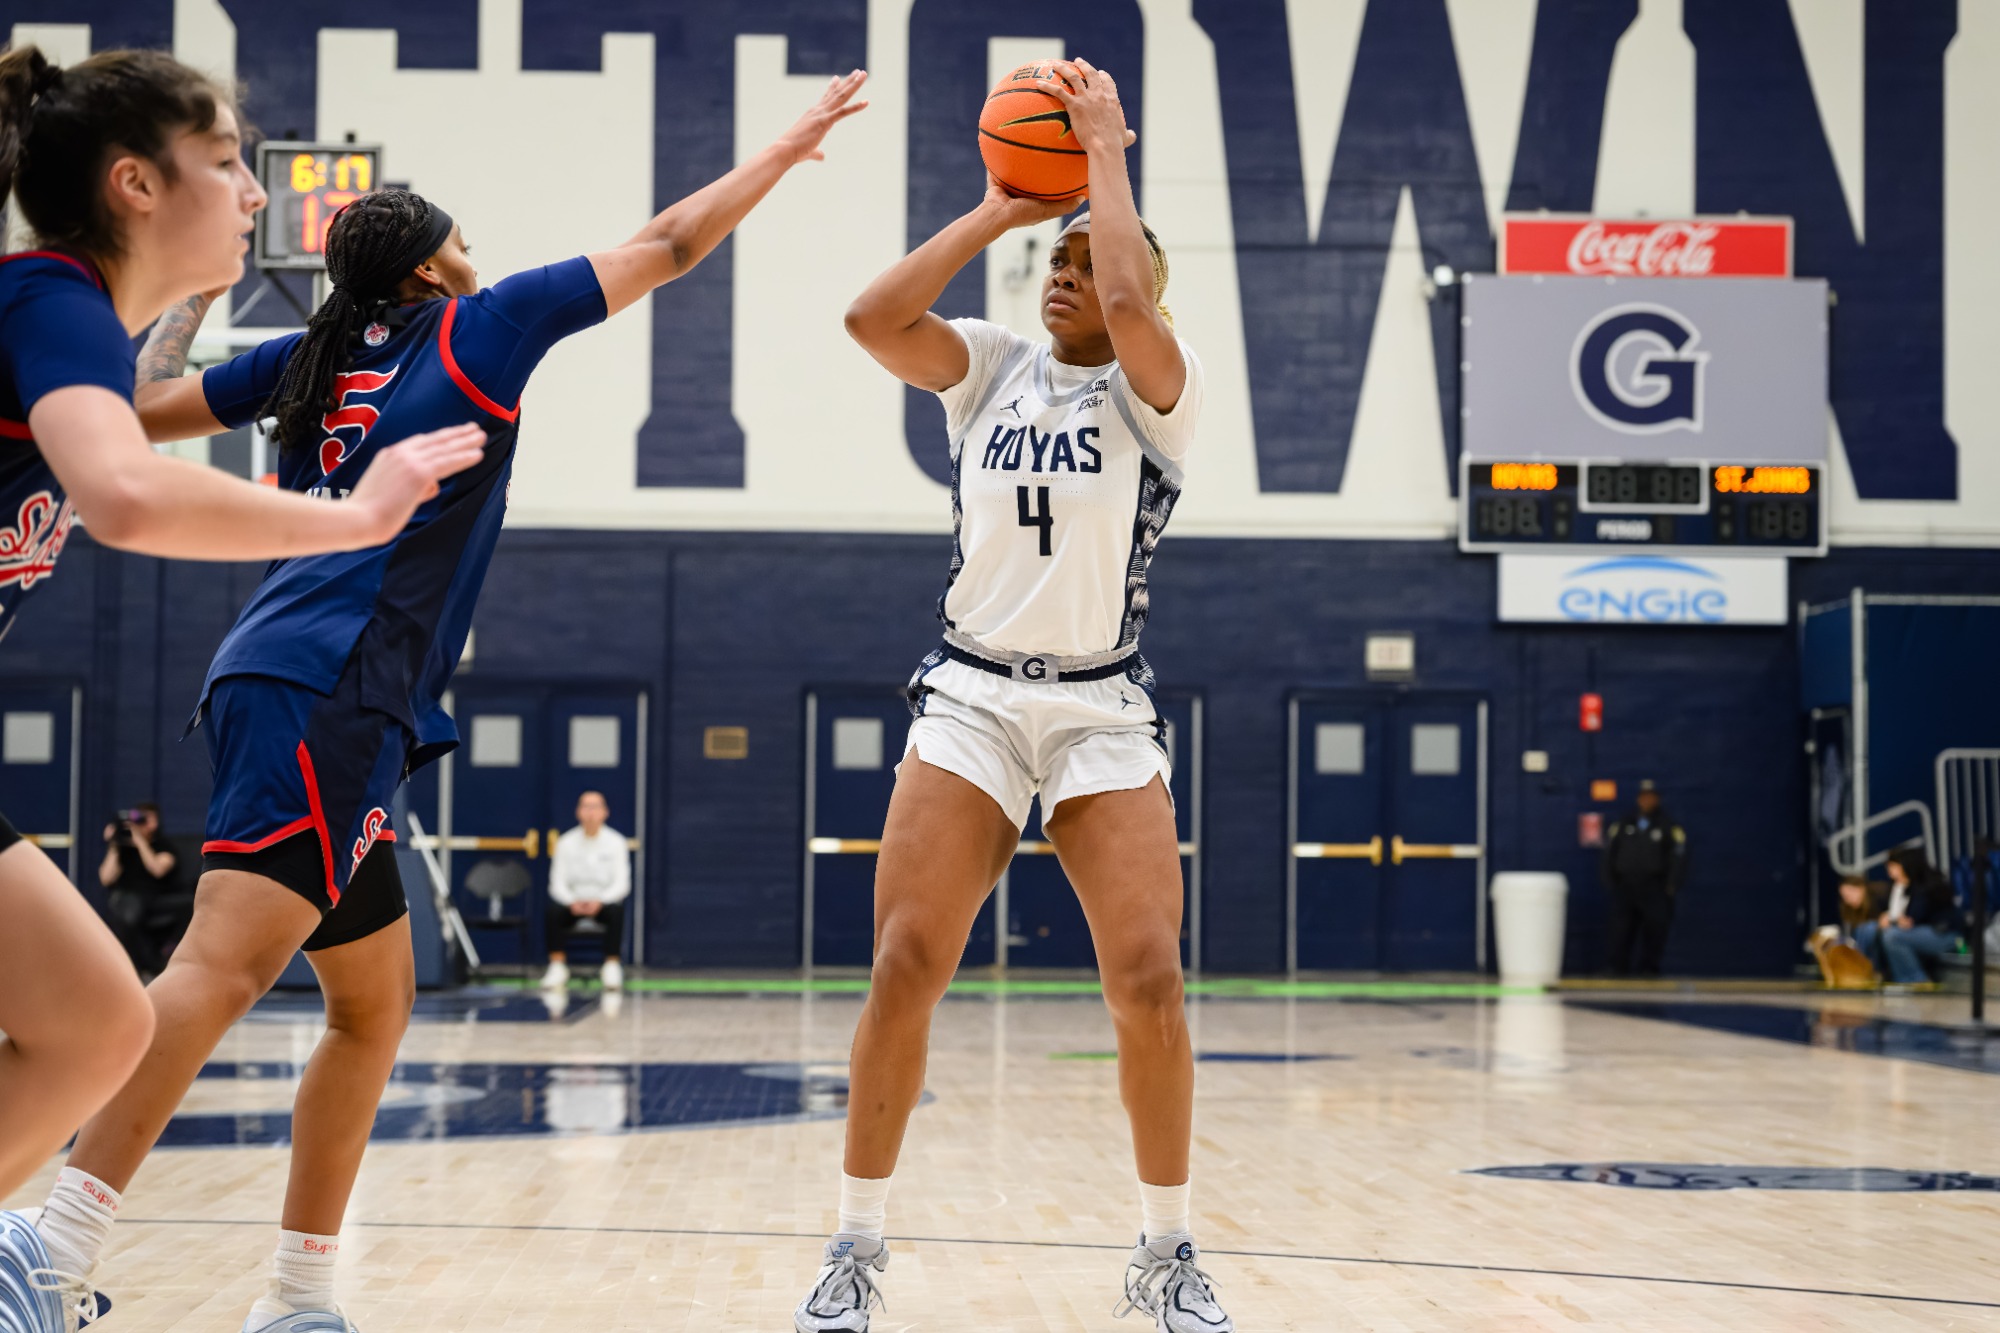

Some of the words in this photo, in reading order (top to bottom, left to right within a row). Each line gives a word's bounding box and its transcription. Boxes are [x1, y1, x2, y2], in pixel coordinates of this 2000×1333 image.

[1011, 66, 1056, 82] ELI
[291, 153, 371, 192] 6:17
[1568, 300, 1711, 436] G
[319, 362, 400, 478] 5
[981, 424, 1102, 474] HOYAS
[1016, 485, 1054, 557] 4
[1021, 656, 1048, 681] G
